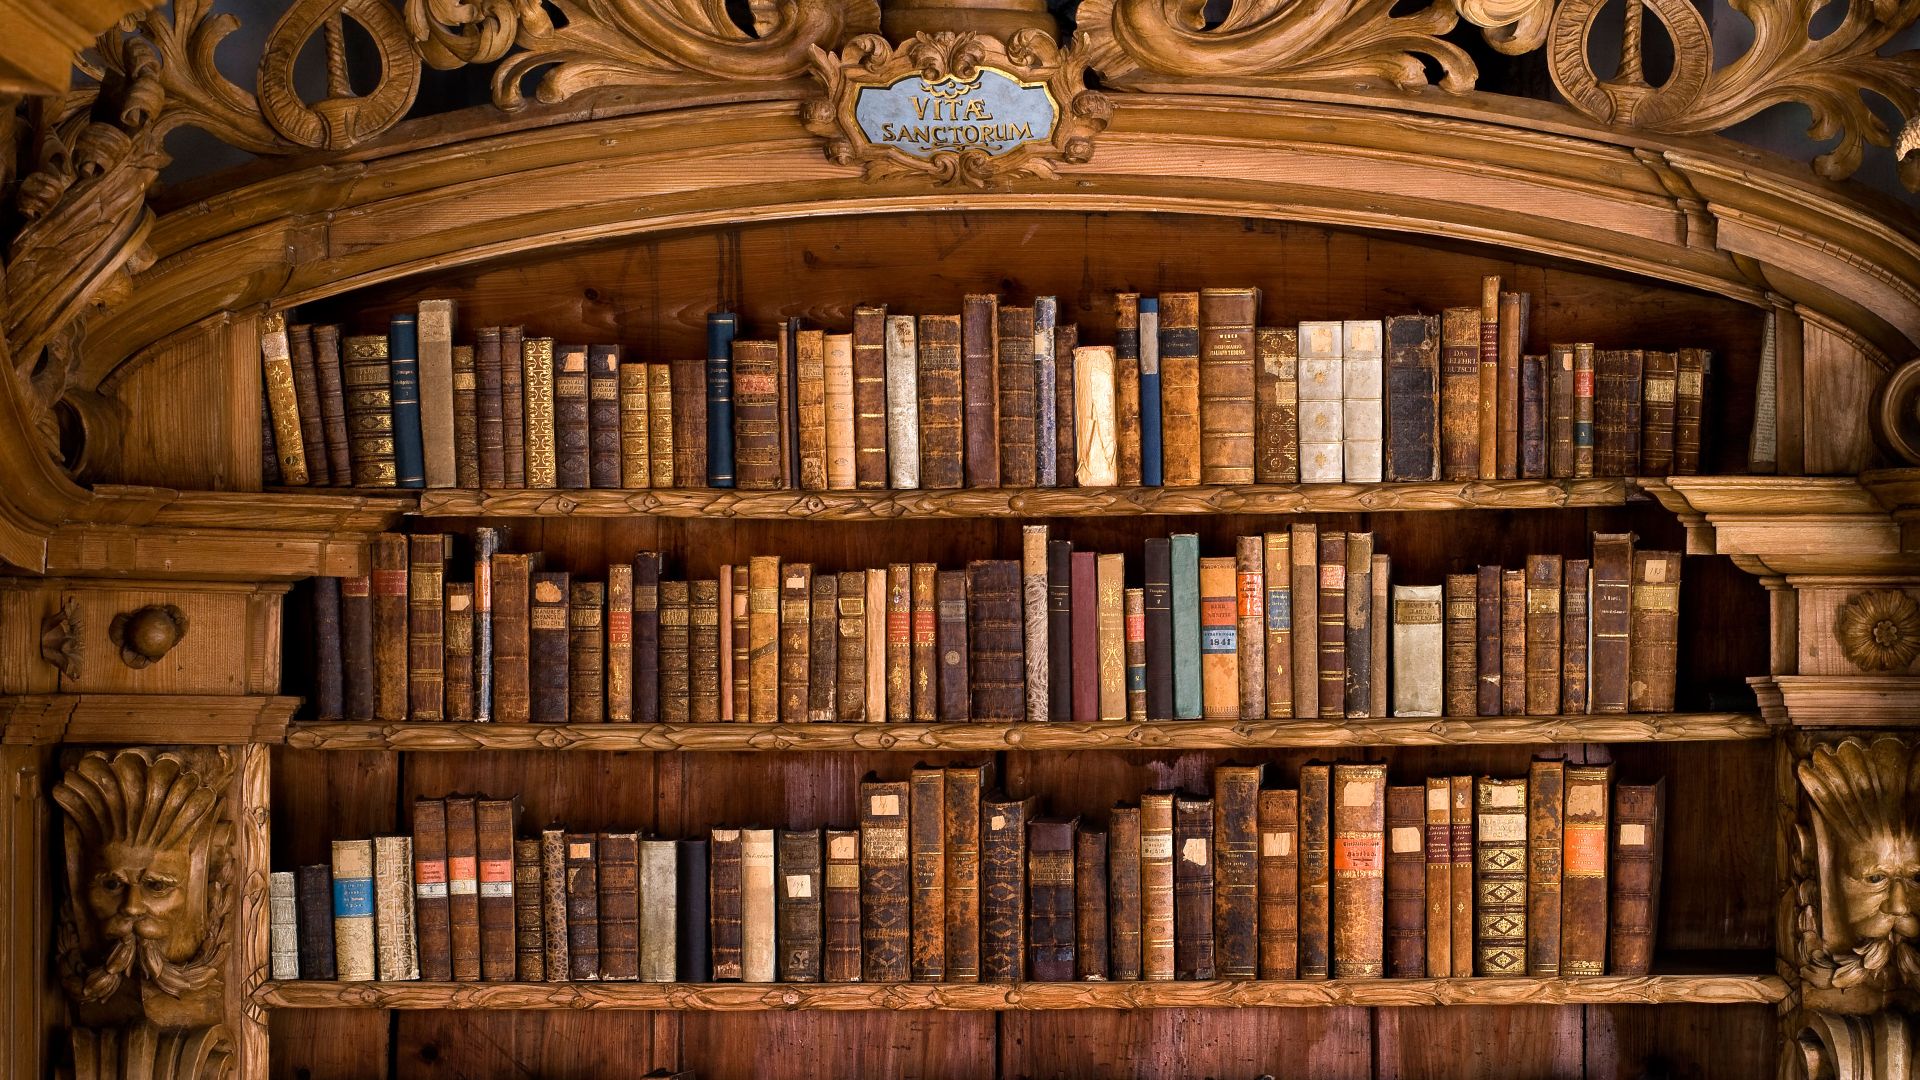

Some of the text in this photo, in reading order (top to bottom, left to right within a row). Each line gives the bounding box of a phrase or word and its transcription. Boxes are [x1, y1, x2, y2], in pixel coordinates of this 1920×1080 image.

[909, 96, 994, 122] VITÆ
[882, 121, 1034, 144] SANCTORUM
[1453, 350, 1469, 358] DAS
[1209, 638, 1232, 646] 1841
